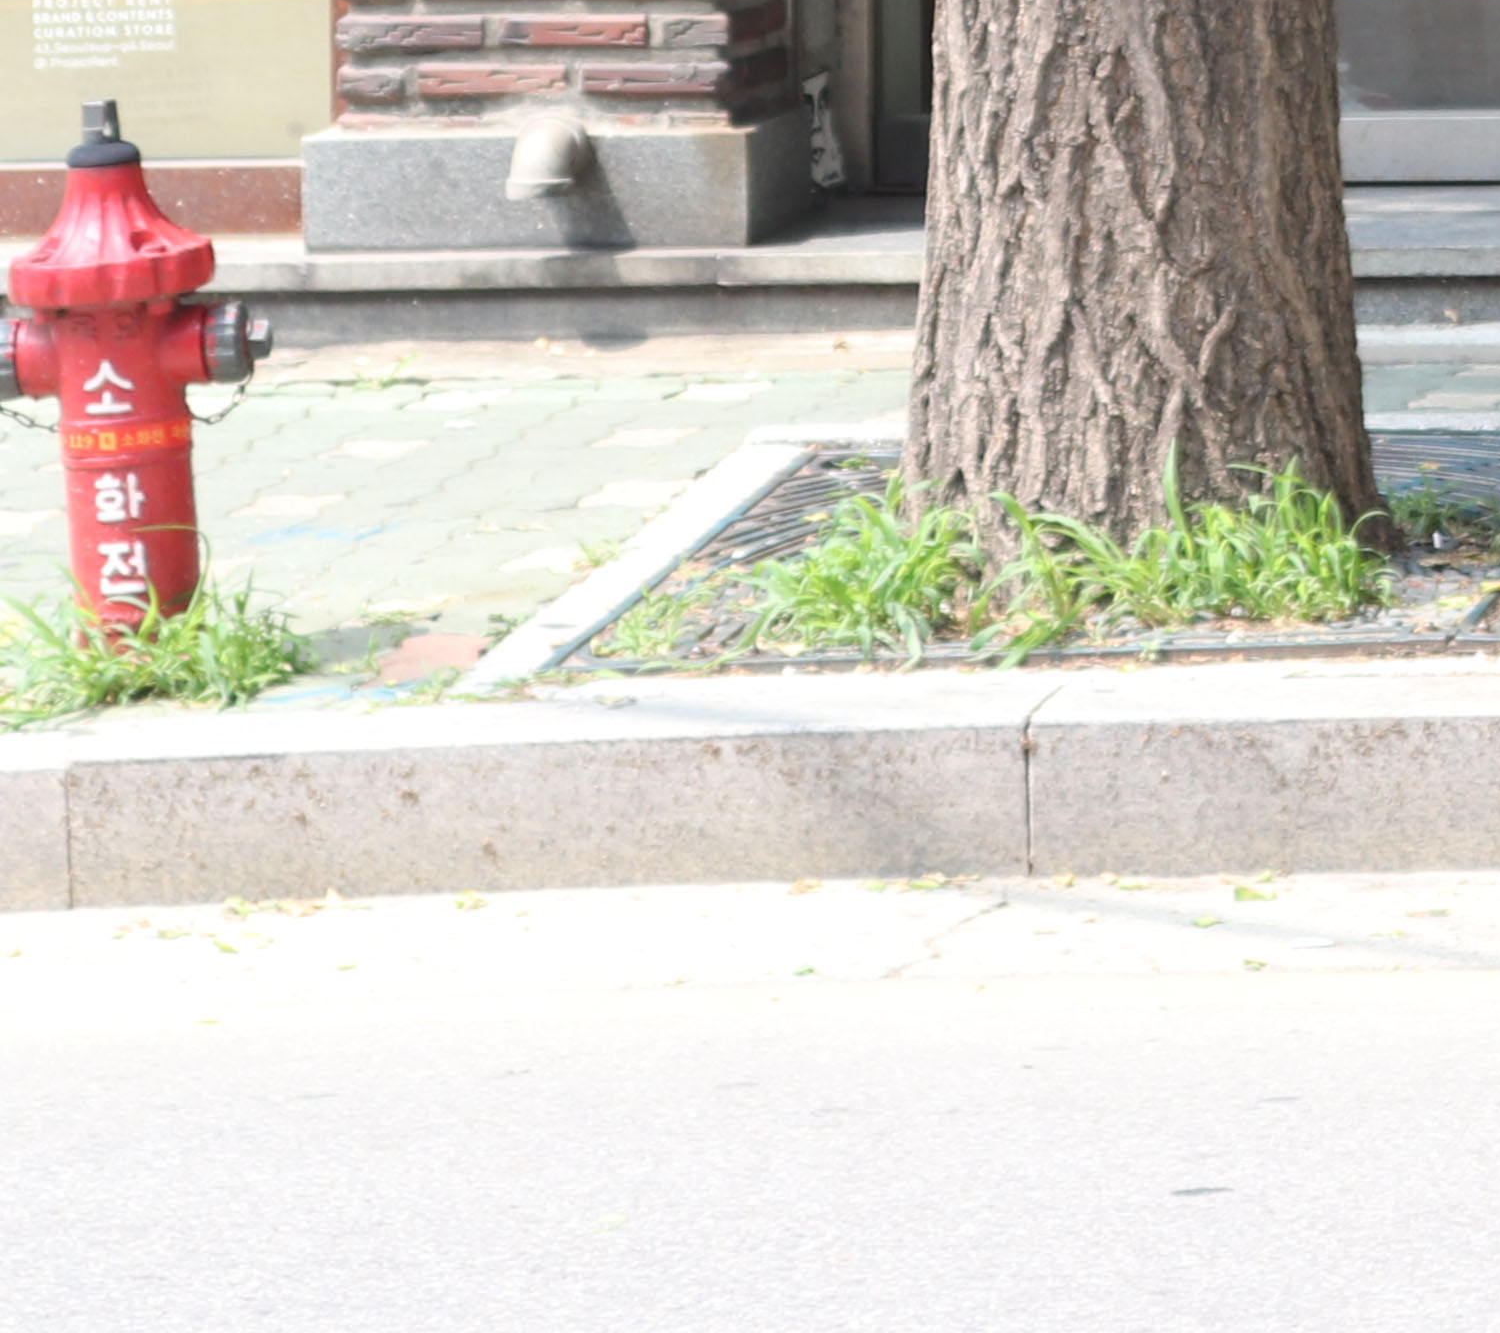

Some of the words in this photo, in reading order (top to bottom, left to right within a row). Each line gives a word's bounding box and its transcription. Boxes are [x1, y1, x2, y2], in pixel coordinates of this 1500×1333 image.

[32, 11, 81, 24] BRAND
[96, 8, 174, 22] CONTENTS
[33, 26, 117, 40] CURATION
[124, 23, 174, 37] STORE
[82, 359, 148, 597] 소화전
